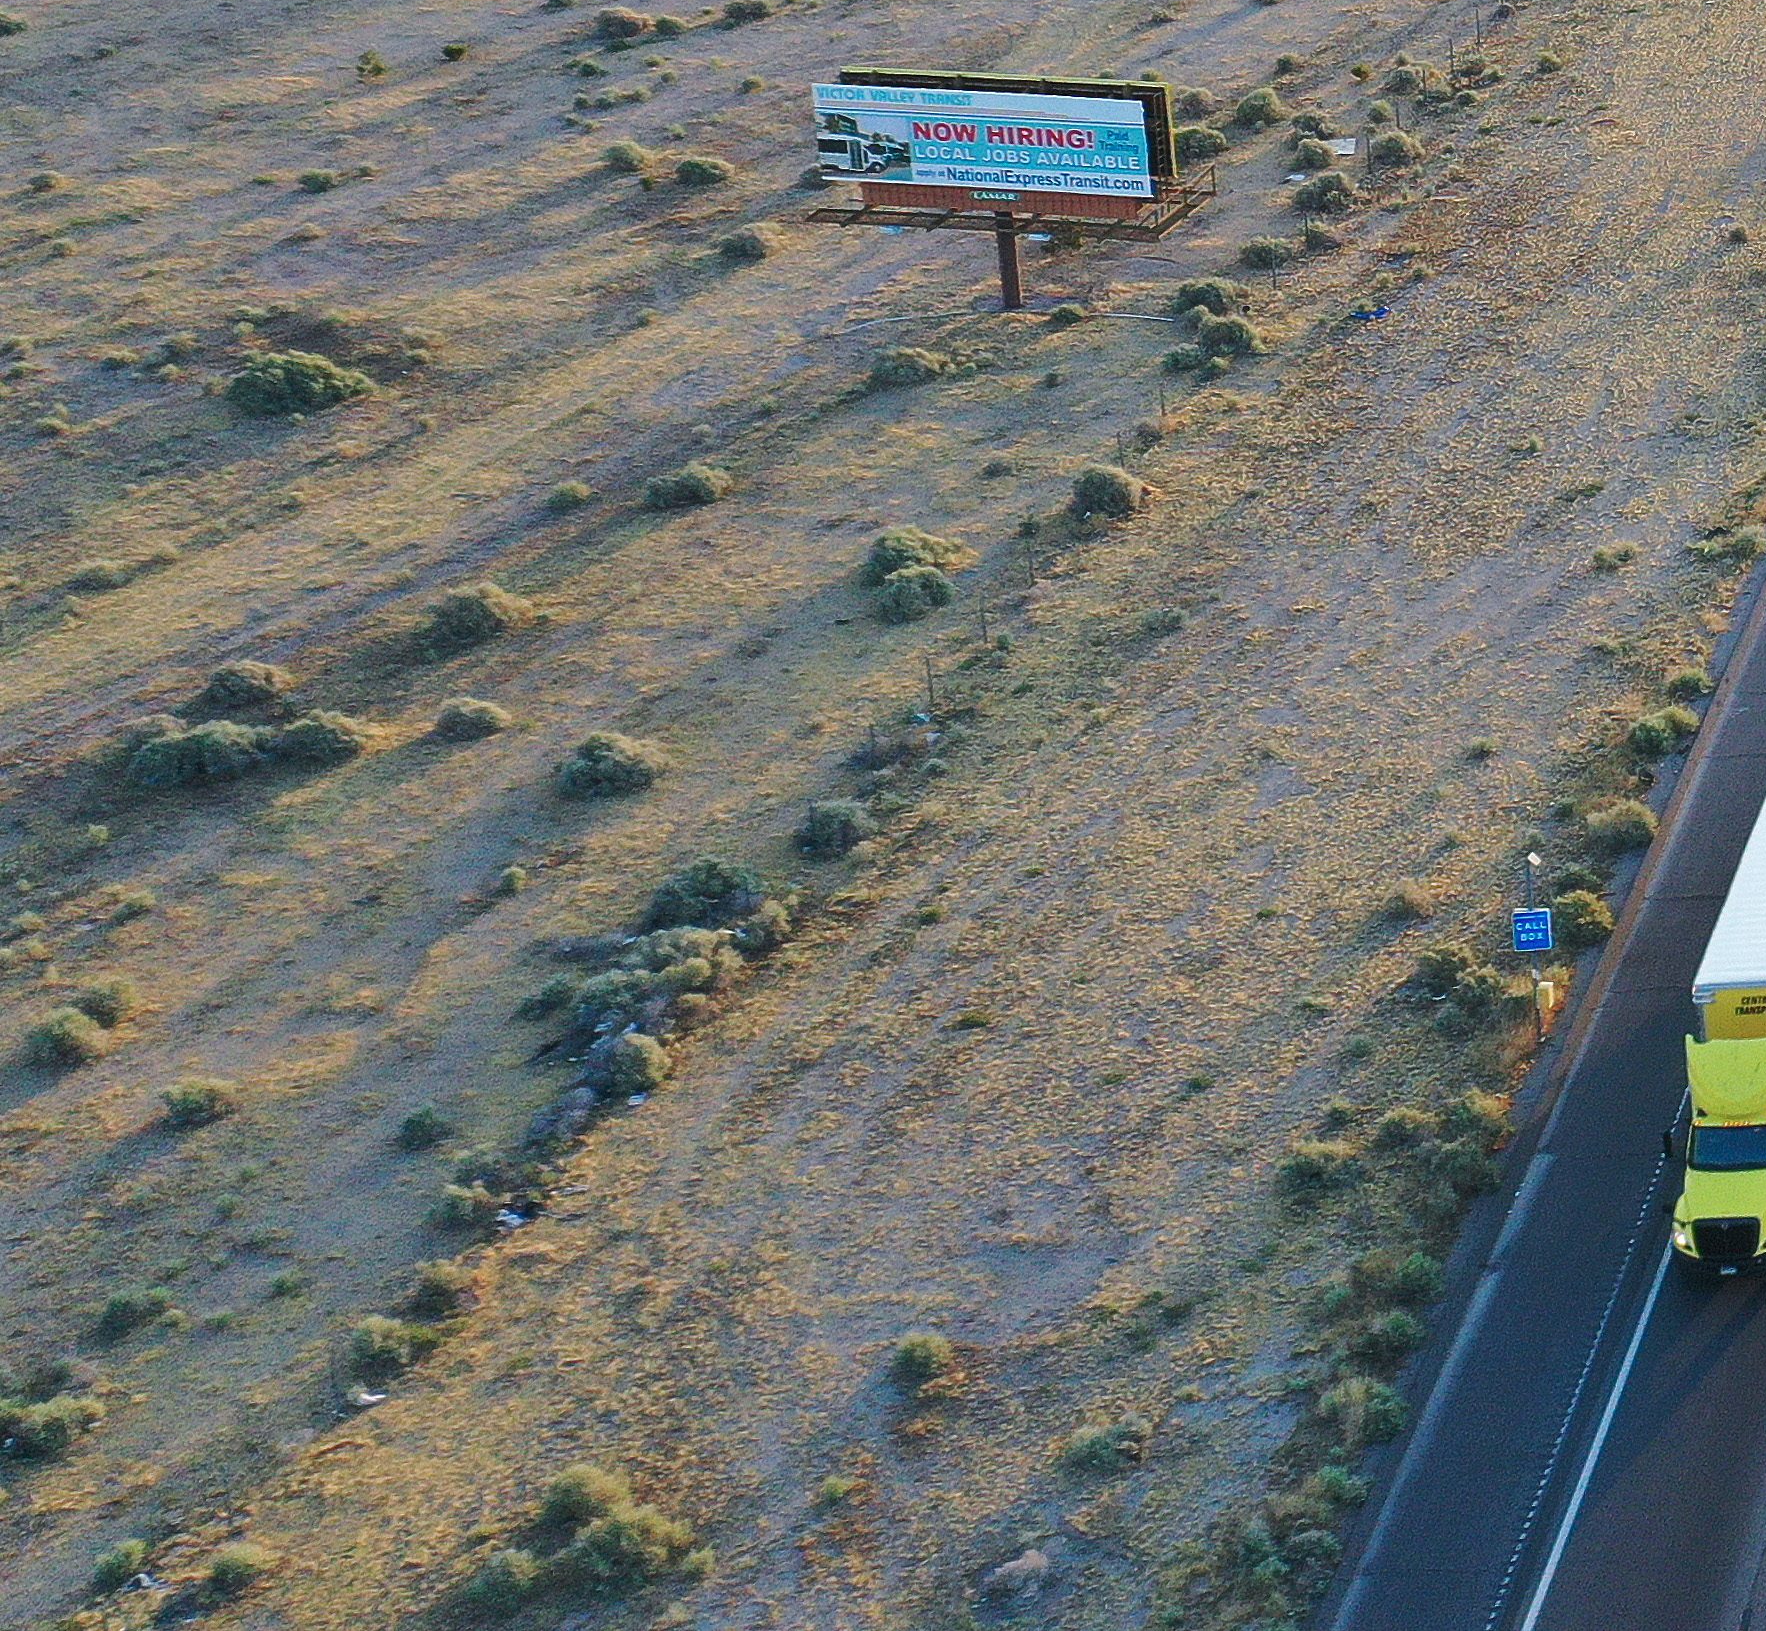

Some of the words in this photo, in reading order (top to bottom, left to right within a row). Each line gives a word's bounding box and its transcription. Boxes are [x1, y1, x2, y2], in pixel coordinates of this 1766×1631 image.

[815, 86, 865, 101] VICTOR
[870, 89, 916, 103] VALLEY
[920, 92, 973, 106] TRANSIT
[912, 121, 978, 144] NOW
[986, 125, 1096, 150] HIRING!
[1106, 129, 1130, 142] Paid
[1099, 140, 1140, 155] Training
[914, 145, 977, 162] LOCAL
[982, 149, 1031, 164] JOBS
[1036, 152, 1141, 170] AVAILABLE
[946, 167, 1144, 191] NationalExpressTransit.com
[1515, 921, 1547, 931] CALL
[1520, 932, 1545, 942] BOX
